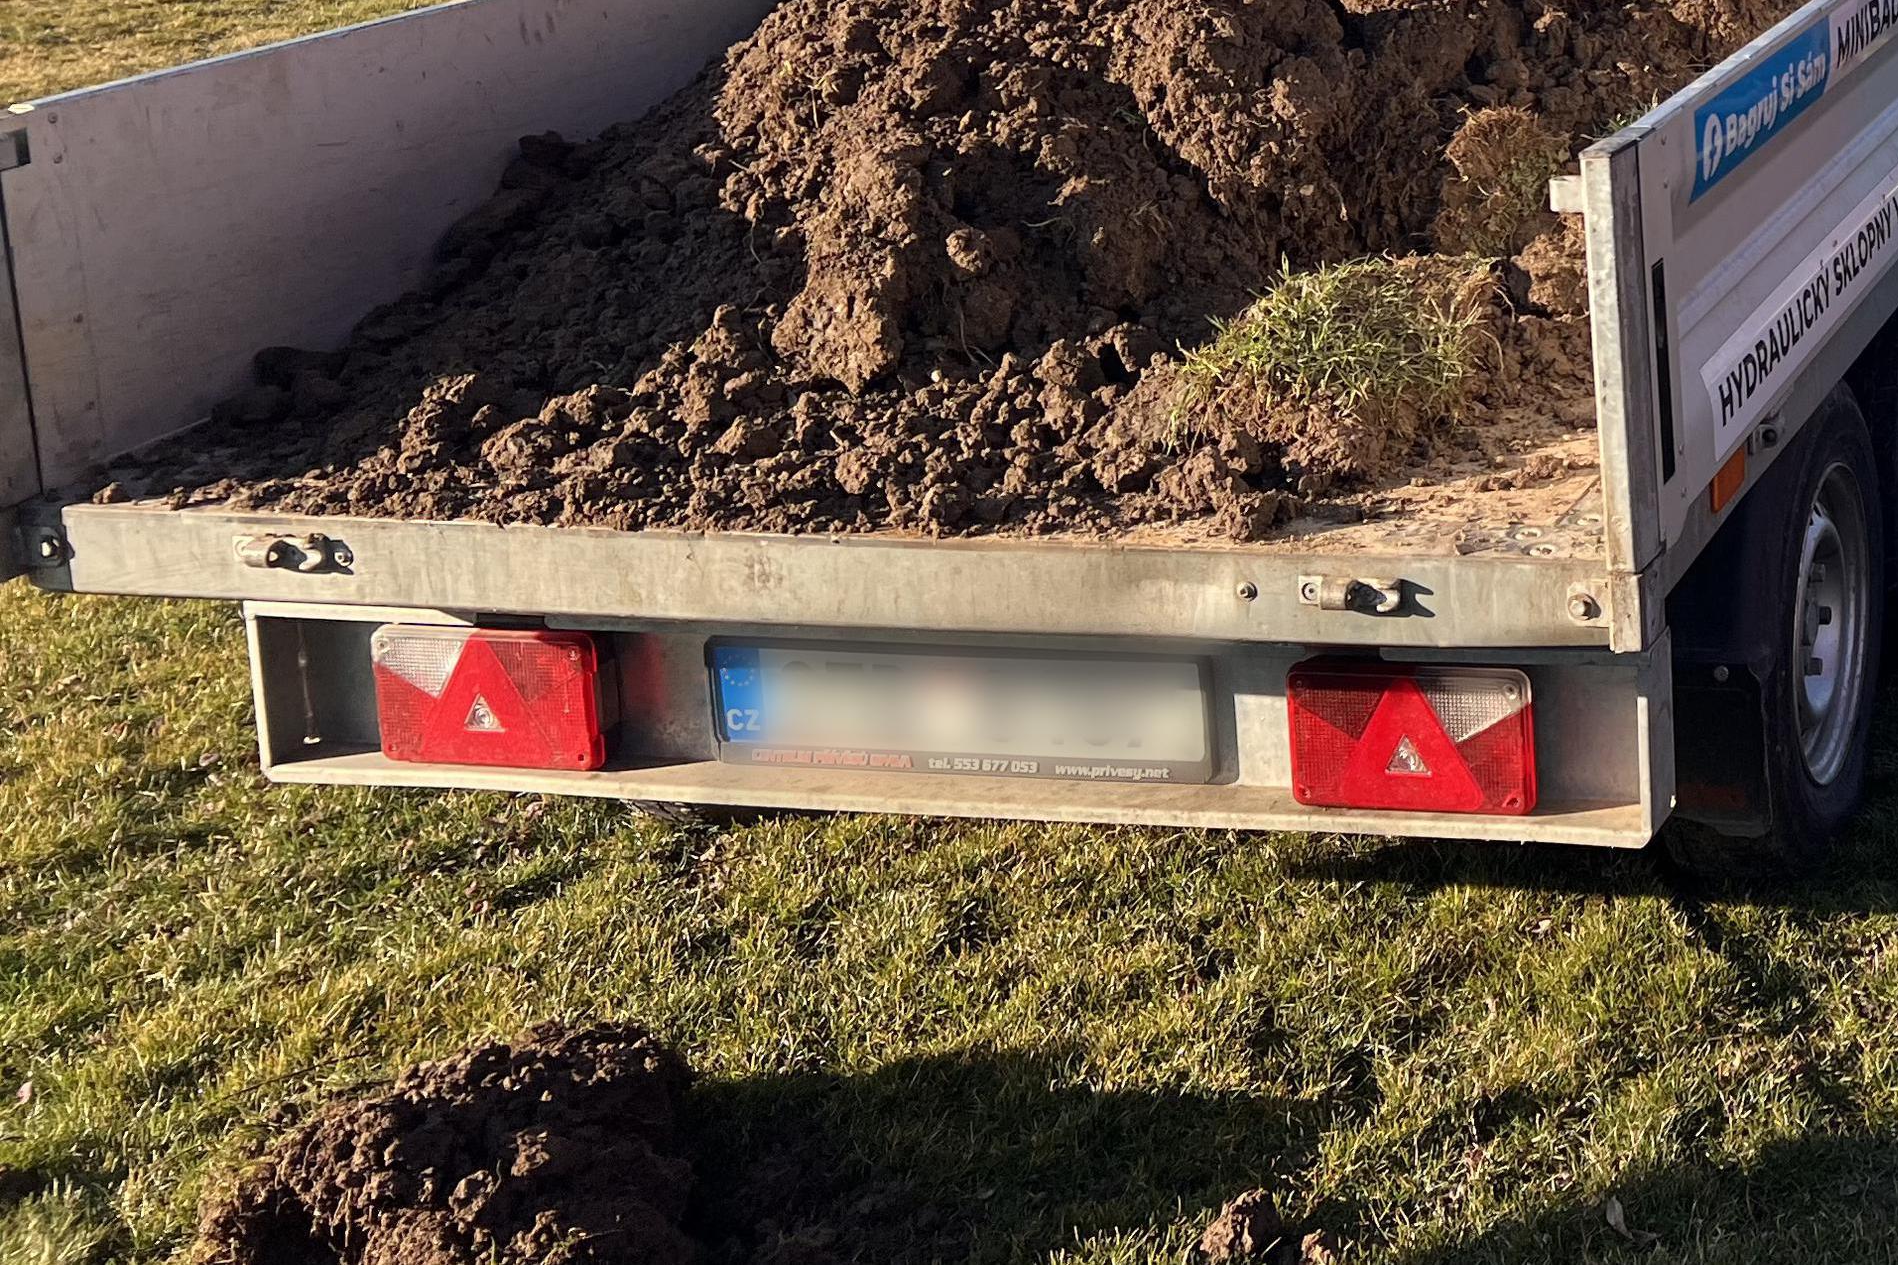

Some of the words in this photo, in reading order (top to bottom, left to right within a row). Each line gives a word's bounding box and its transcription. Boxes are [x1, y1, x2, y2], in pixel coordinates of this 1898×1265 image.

[1725, 75, 1778, 156] Bagruj
[1780, 63, 1795, 112] Si
[1797, 51, 1826, 99] Sám
[1718, 259, 1830, 427] HYDRAULICKÝ
[1833, 194, 1892, 296] SKLOPNÝ
[726, 708, 761, 731] CZ
[953, 758, 980, 771] 553
[1055, 763, 1170, 780] www.privesy.net
